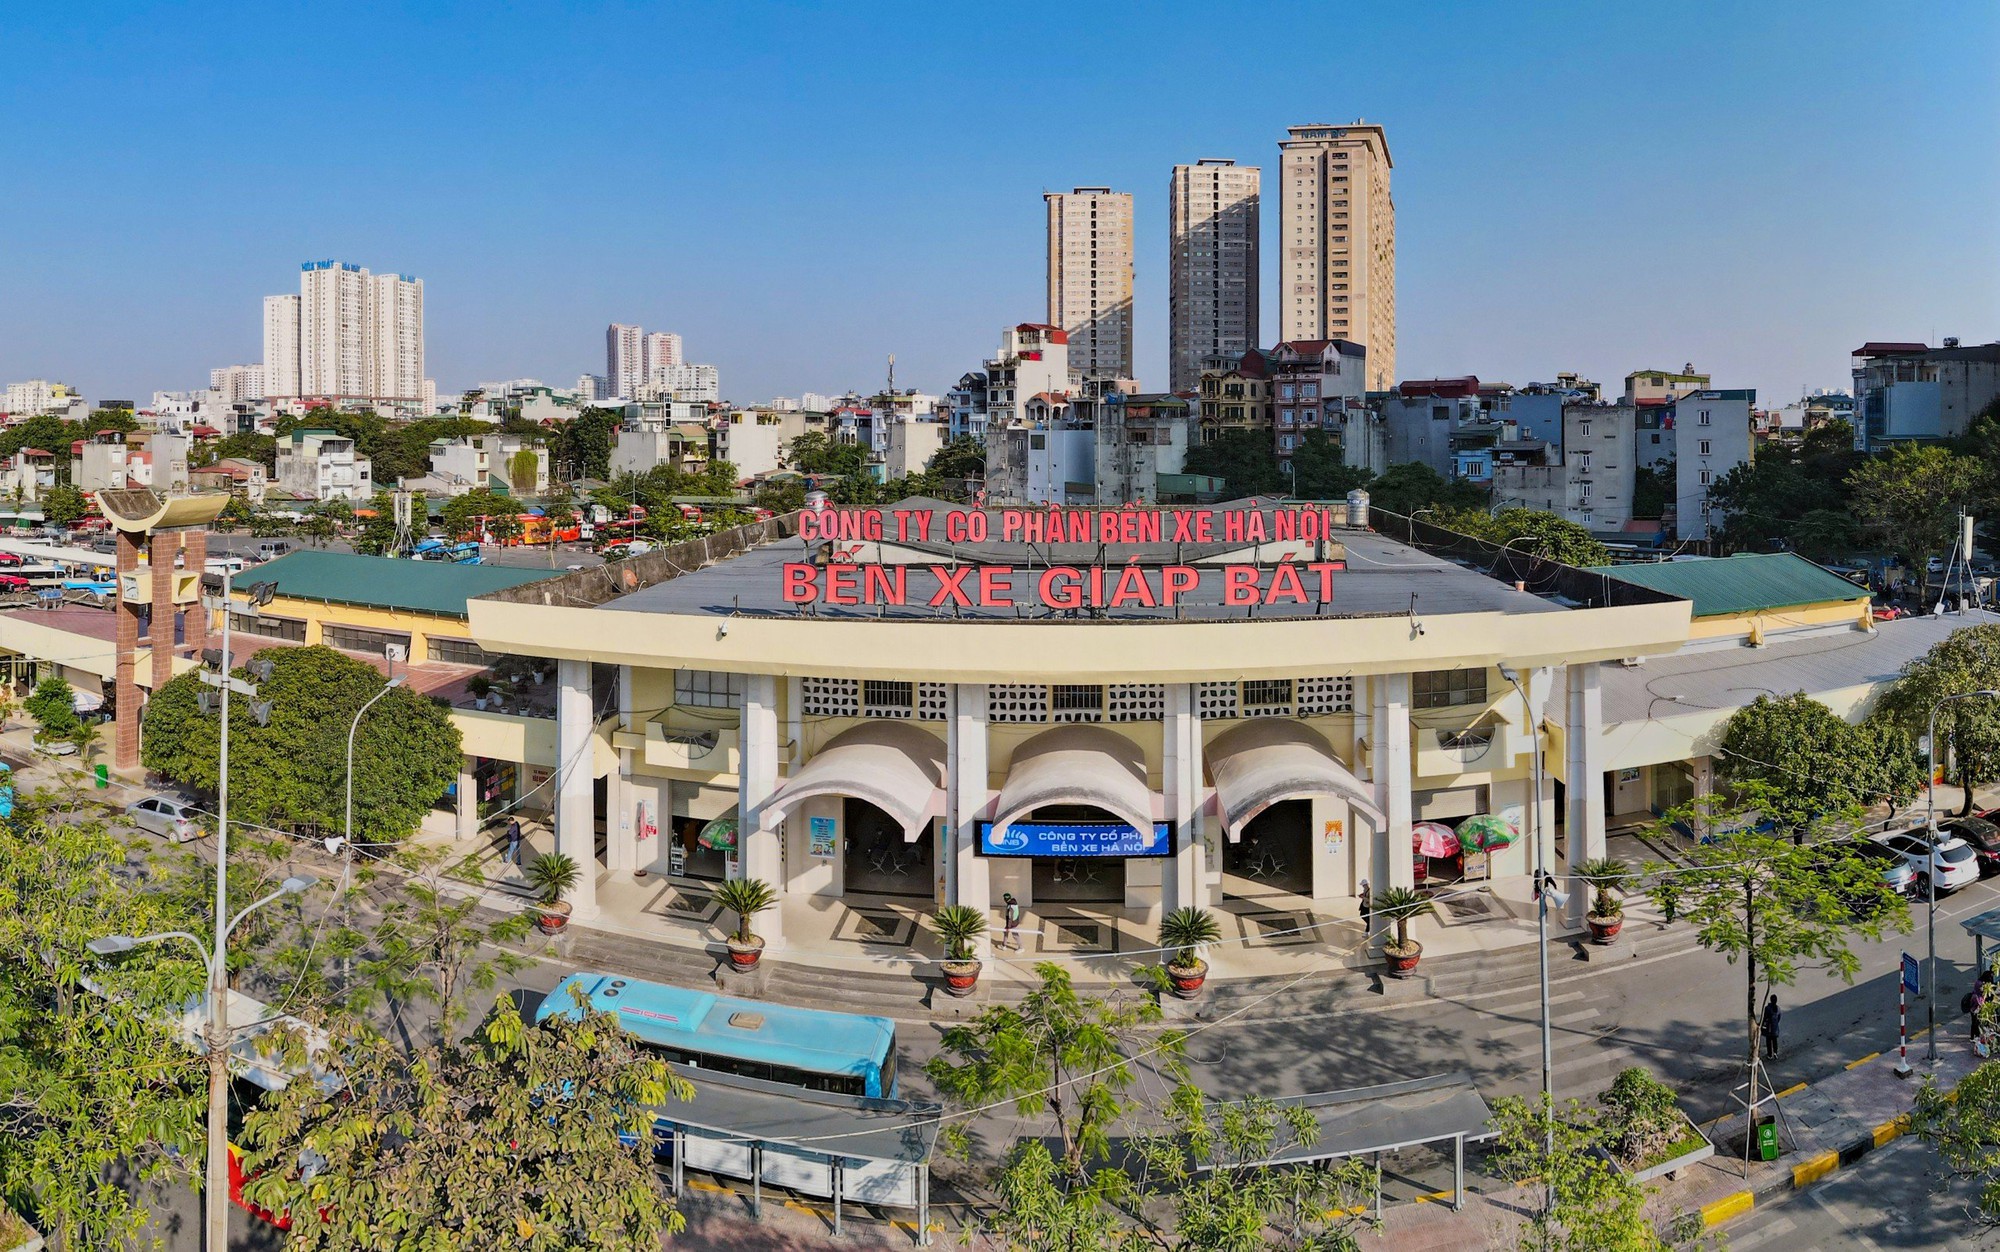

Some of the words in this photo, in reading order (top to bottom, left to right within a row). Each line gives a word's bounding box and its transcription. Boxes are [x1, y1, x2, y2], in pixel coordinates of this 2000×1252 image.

[799, 501, 883, 541] CÔNG
[893, 509, 933, 543] TY
[1003, 500, 1091, 544] PHẦN
[1099, 497, 1161, 544] BẾN
[1173, 510, 1213, 543] XE
[1225, 500, 1267, 542] HÀ
[1275, 502, 1331, 547] NỘI
[783, 545, 906, 605] BẾN
[928, 564, 1013, 607] XE
[1038, 554, 1200, 609] GIÁP
[1224, 552, 1346, 606] BÁT
[1039, 831, 1076, 840] CÔNG
[1081, 844, 1098, 852] XE
[1101, 842, 1120, 852] HÀ
